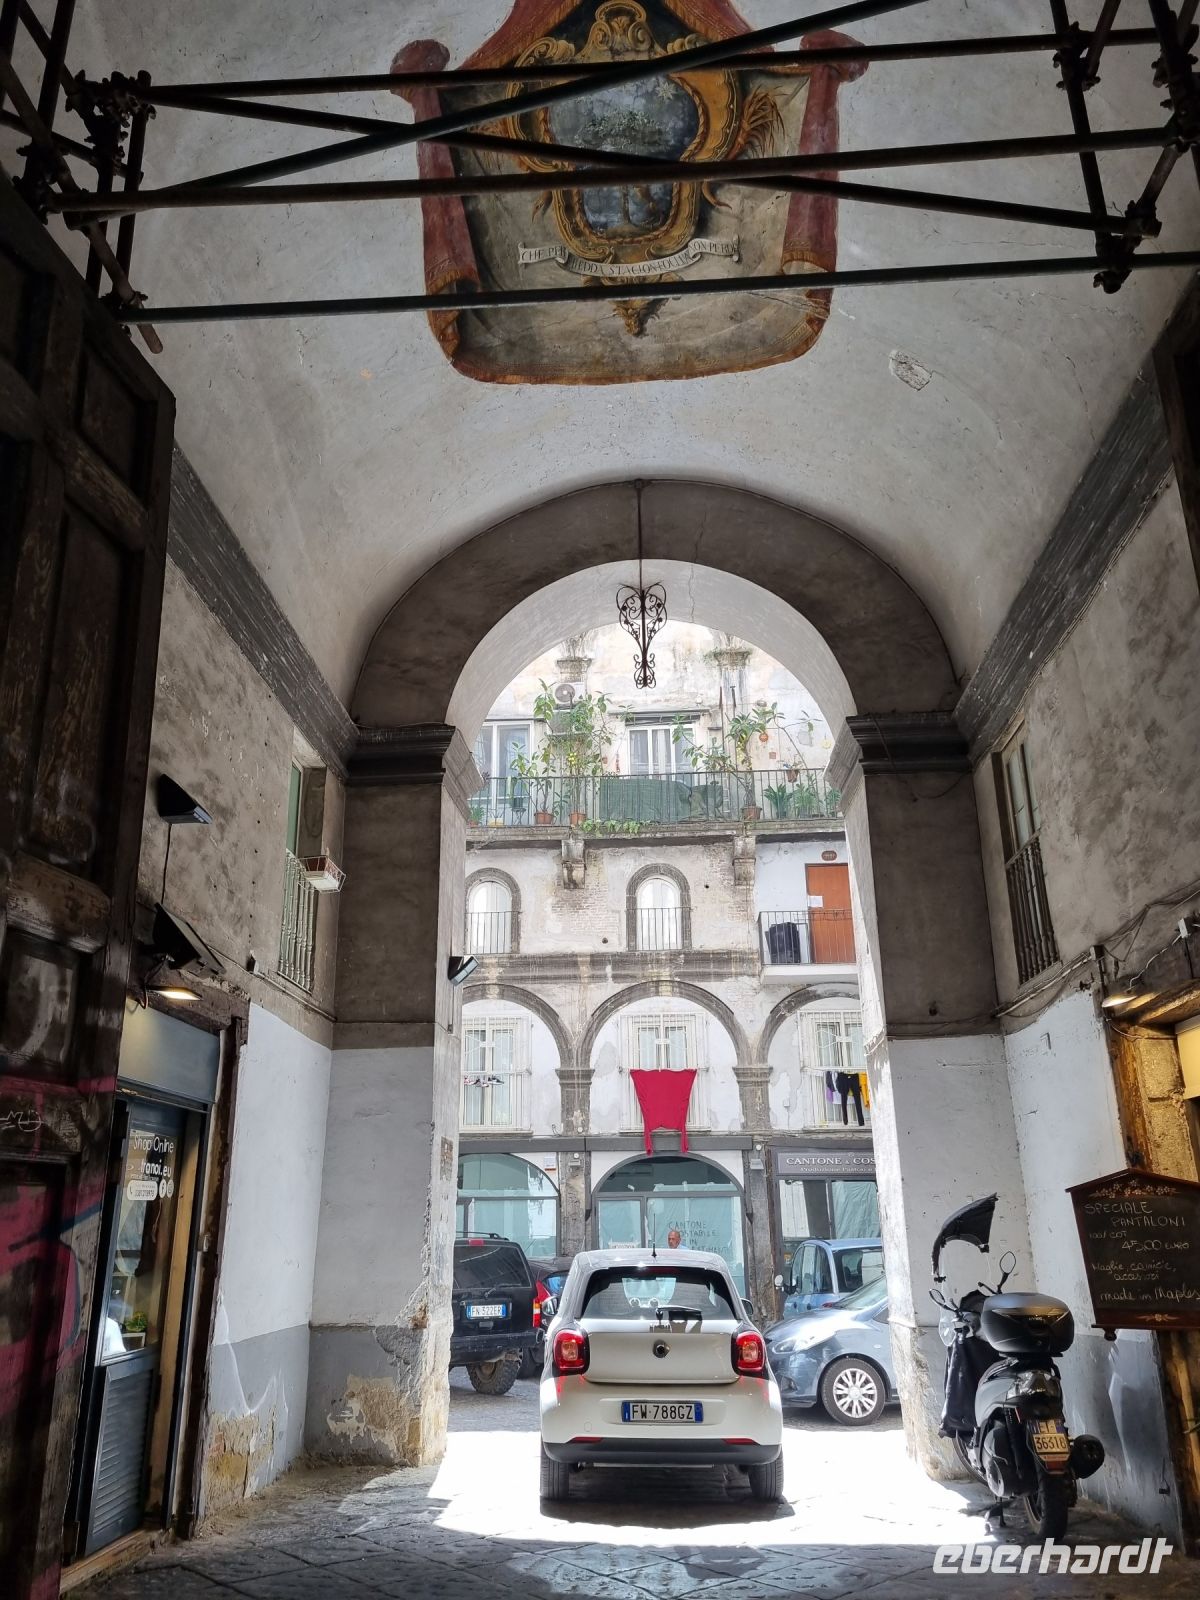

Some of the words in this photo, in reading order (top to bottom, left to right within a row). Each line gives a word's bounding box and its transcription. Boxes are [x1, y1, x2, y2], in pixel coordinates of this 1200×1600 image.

[521, 249, 543, 261] CHE
[133, 1134, 152, 1153] Shop
[153, 1136, 174, 1153] Online
[786, 1157, 842, 1165] CANTONE
[1084, 1201, 1153, 1215] SPECIALE
[1111, 1215, 1186, 1227] PANTALONI
[1100, 1287, 1137, 1301] made
[631, 1404, 647, 1420] FW
[652, 1404, 693, 1420] 788GZ
